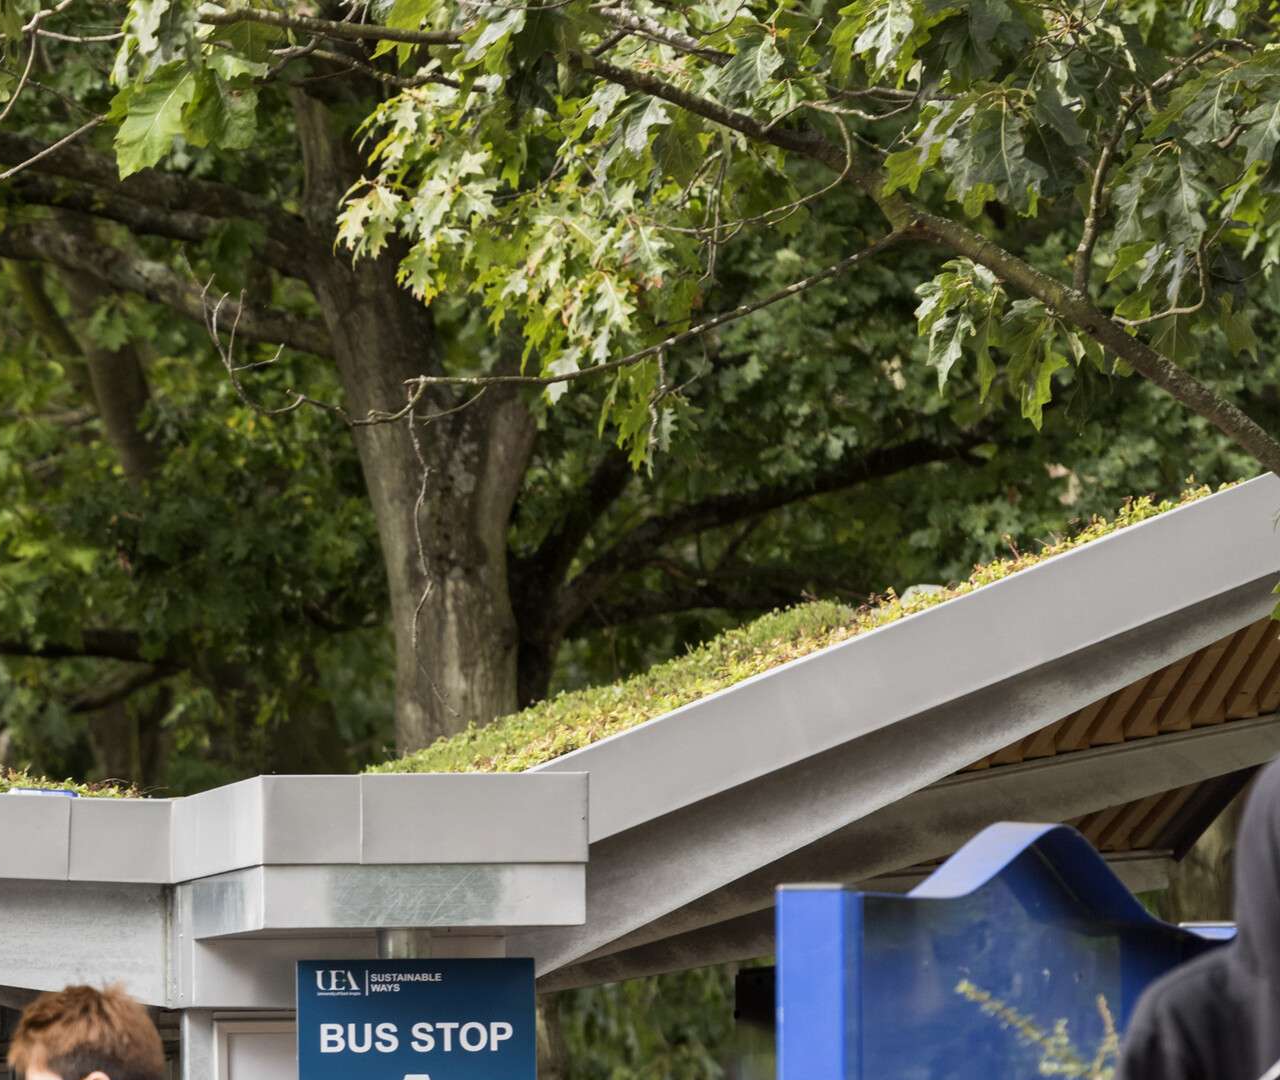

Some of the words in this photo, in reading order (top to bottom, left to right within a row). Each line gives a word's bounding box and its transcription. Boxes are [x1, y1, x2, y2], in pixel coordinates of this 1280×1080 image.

[315, 970, 360, 991] UEA
[370, 973, 443, 982] SUSTAINABLE
[370, 983, 401, 992] WAYS
[320, 1022, 399, 1054] BUS
[410, 1021, 513, 1053] STOP
